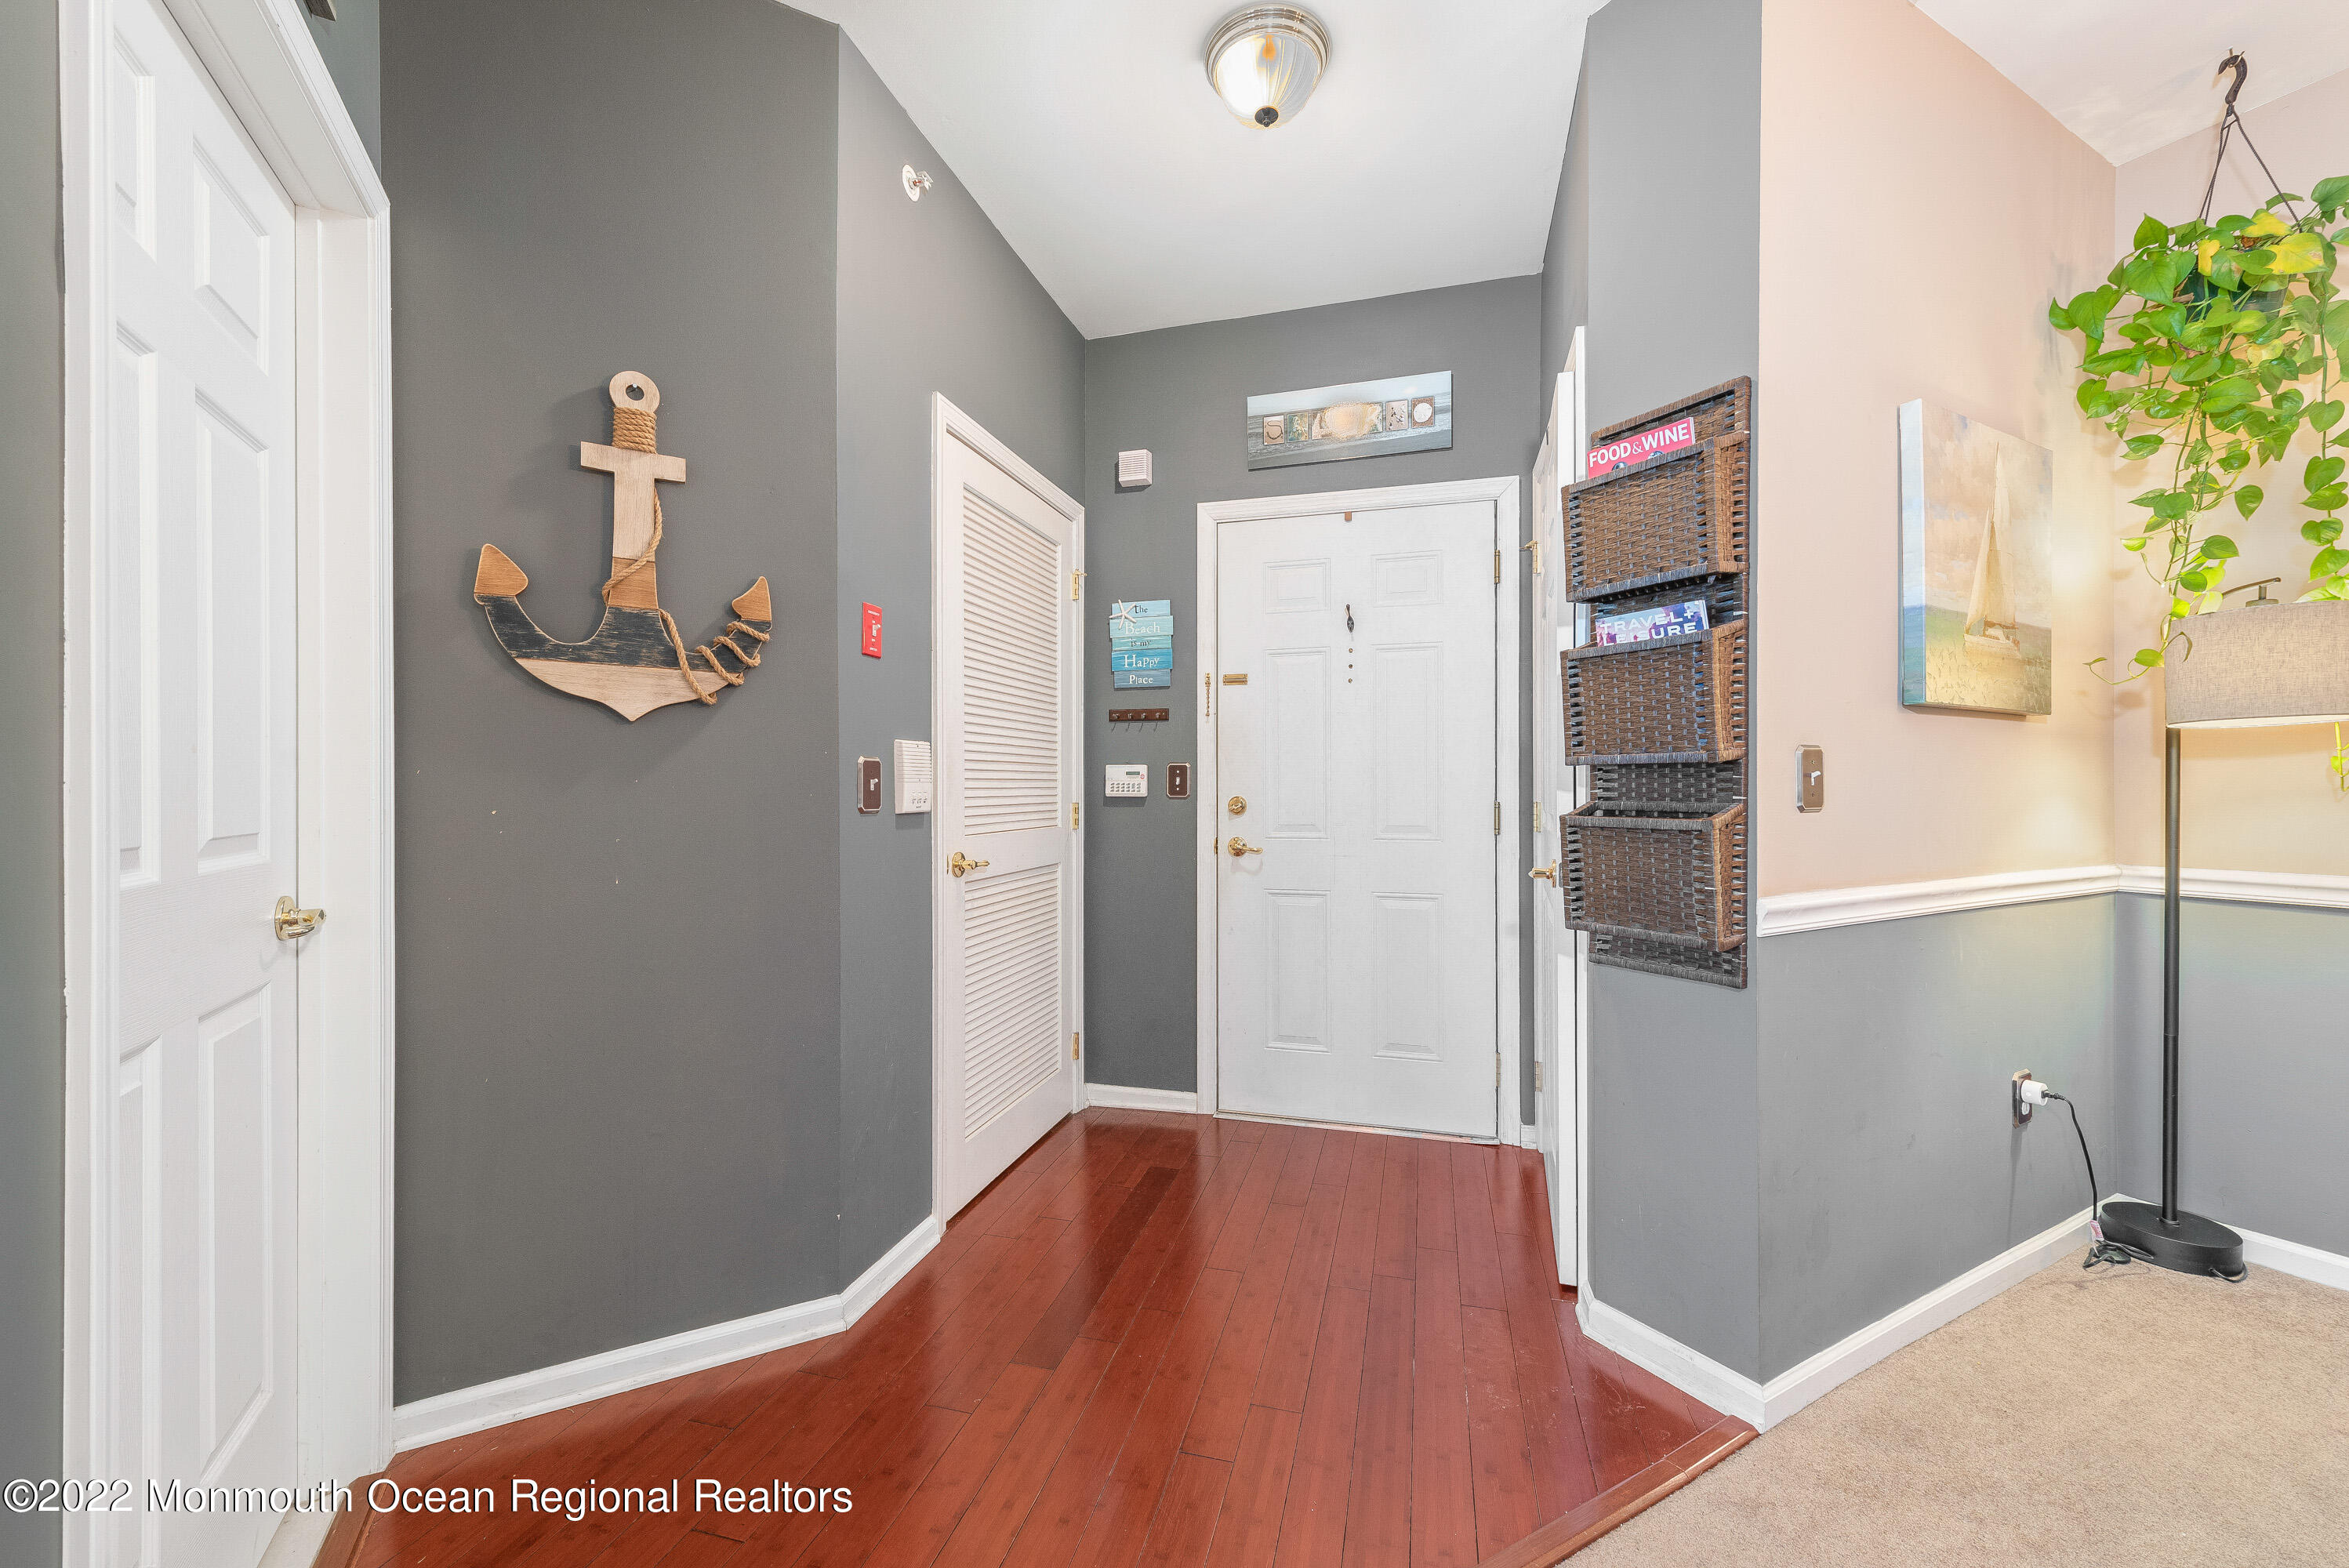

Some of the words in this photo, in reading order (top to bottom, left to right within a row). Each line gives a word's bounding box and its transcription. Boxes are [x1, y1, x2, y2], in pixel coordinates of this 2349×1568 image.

[1135, 605, 1149, 614] the
[1124, 621, 1161, 635] Beach
[1603, 622, 1697, 646] LEISURE
[1131, 638, 1137, 647] is
[1128, 674, 1153, 684] Place
